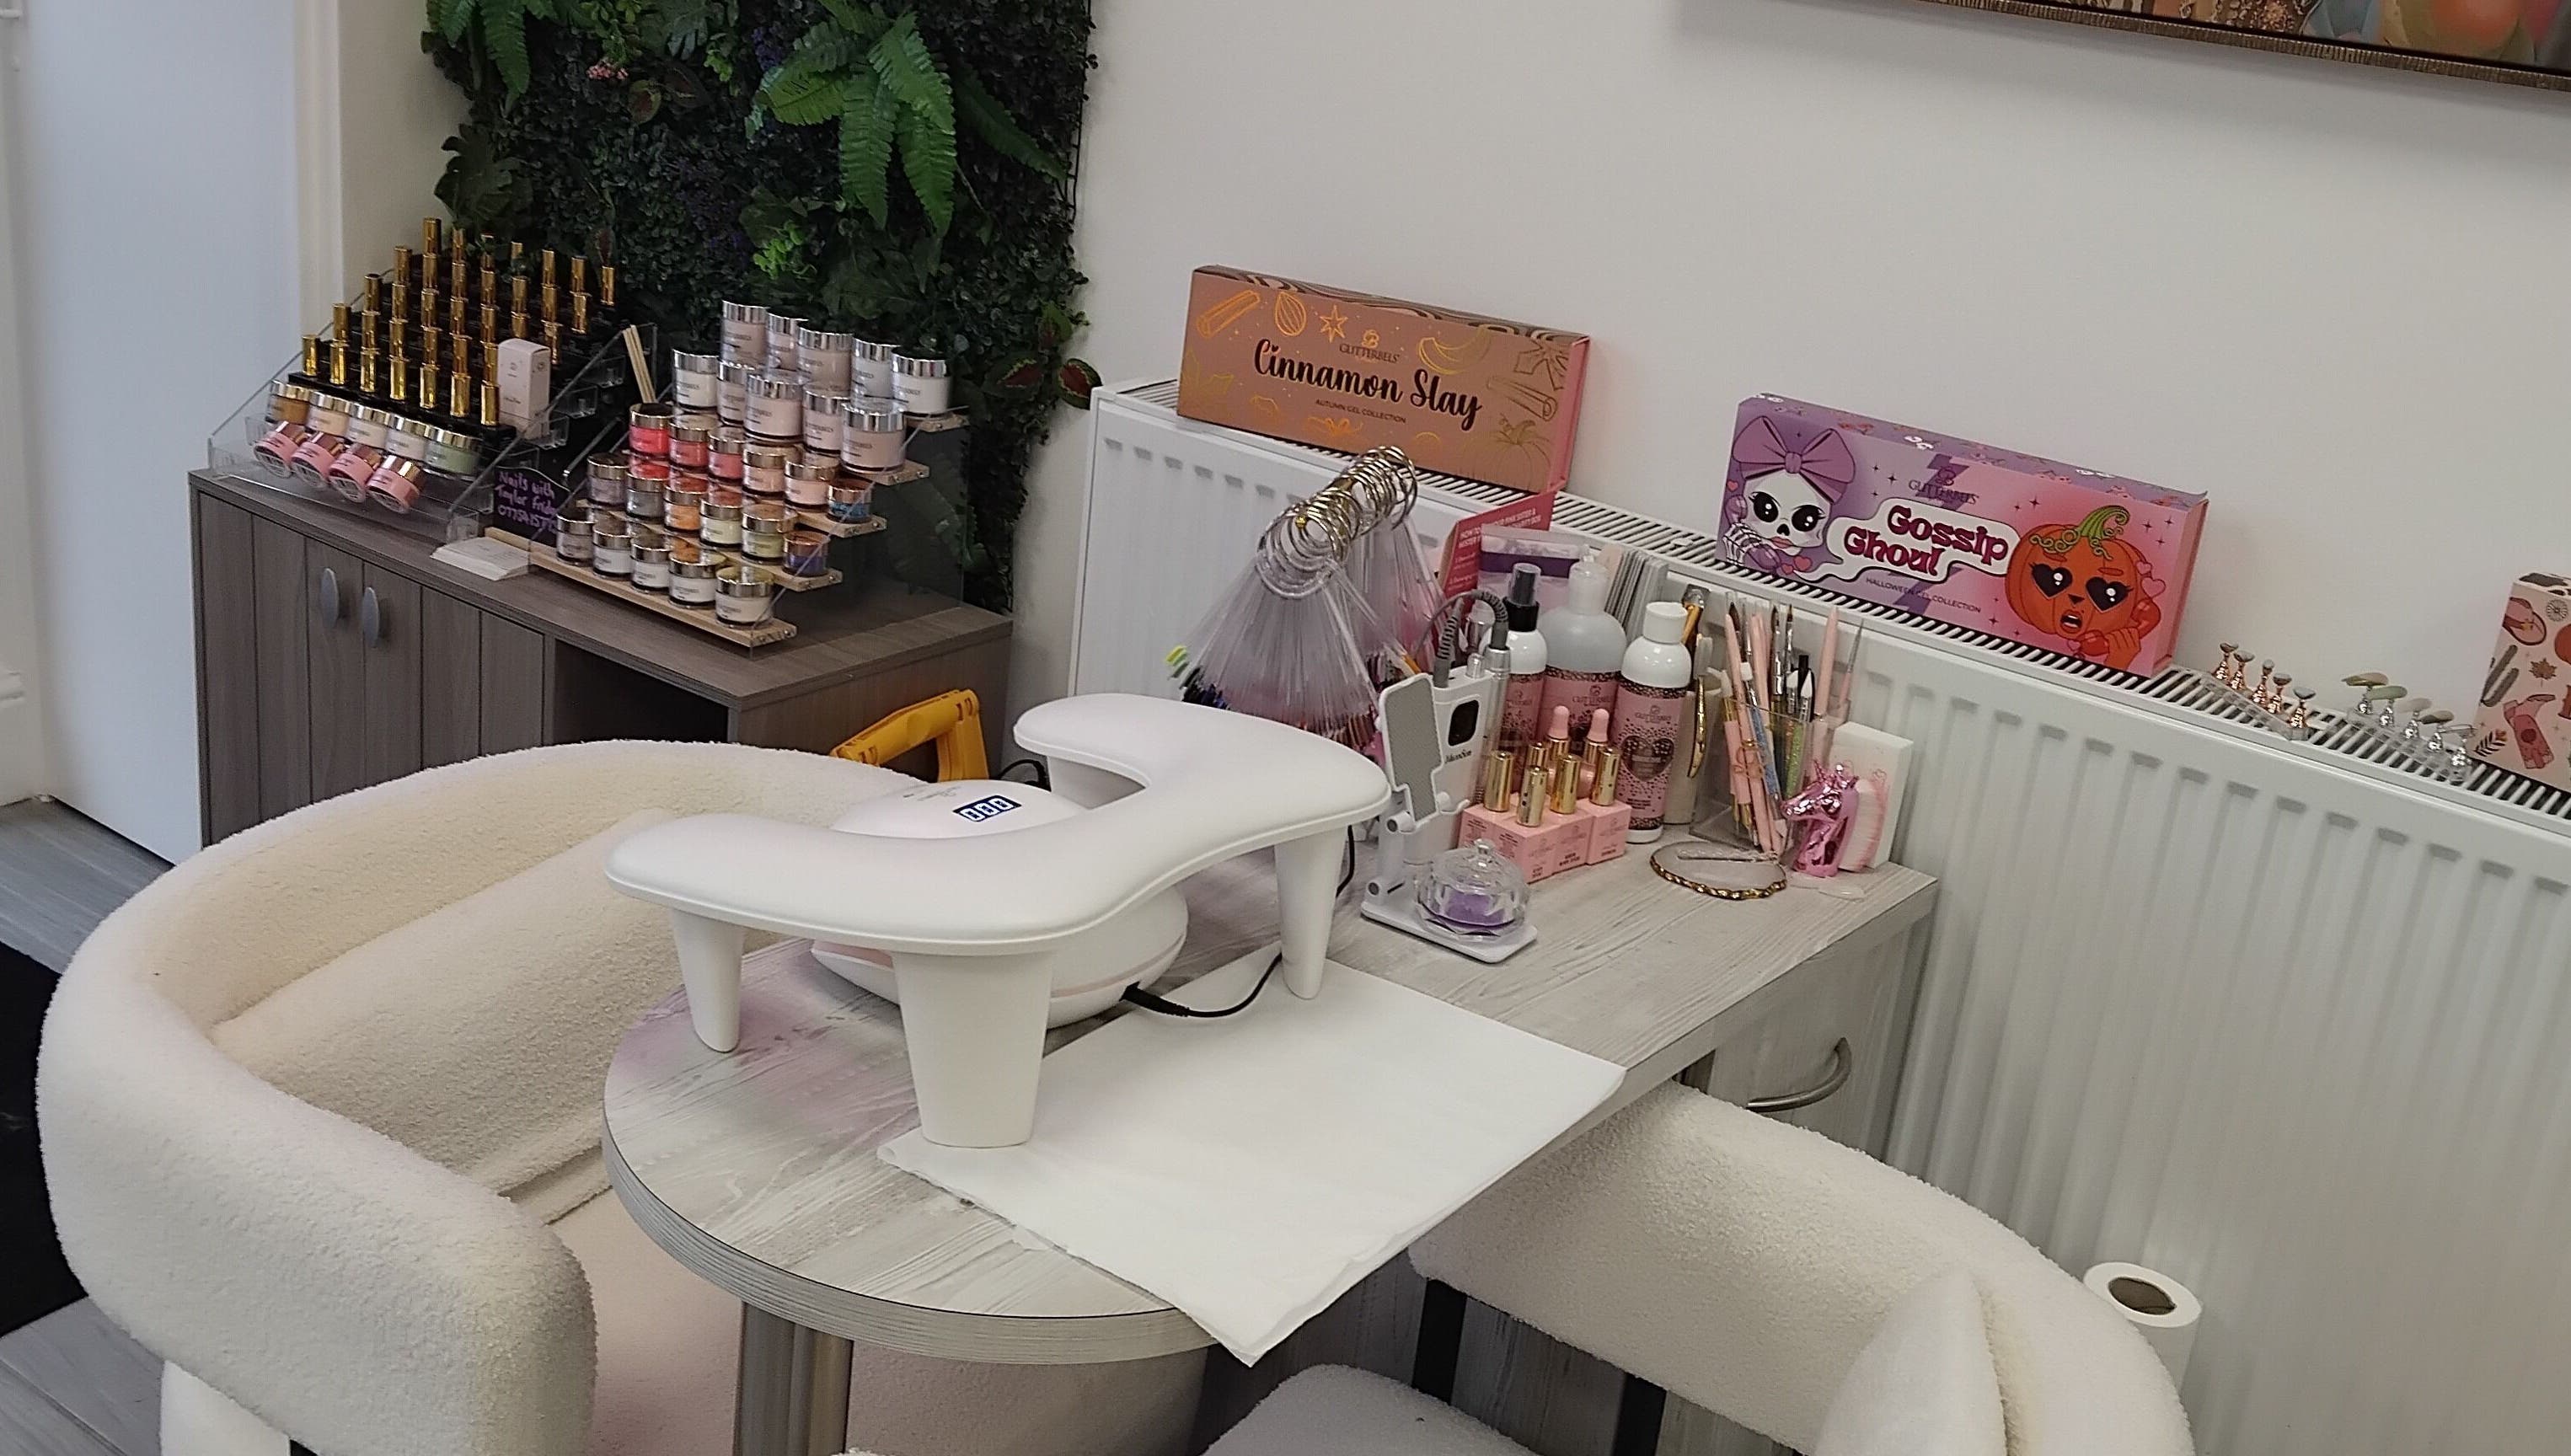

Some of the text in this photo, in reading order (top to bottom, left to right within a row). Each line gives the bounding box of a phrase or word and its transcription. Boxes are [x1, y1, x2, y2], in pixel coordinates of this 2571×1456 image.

[1254, 338, 1482, 432] Cinnamon Slay
[1315, 399, 1406, 424] AUTUMN GEL COLLECTION
[495, 484, 528, 506] Taylor
[499, 471, 555, 499] Nails with
[1844, 526, 1947, 576] Ghoul
[1887, 505, 2009, 566] Gossip
[1866, 577, 1915, 597] HALLOWEEN
[1933, 593, 1981, 613] COLLECTION
